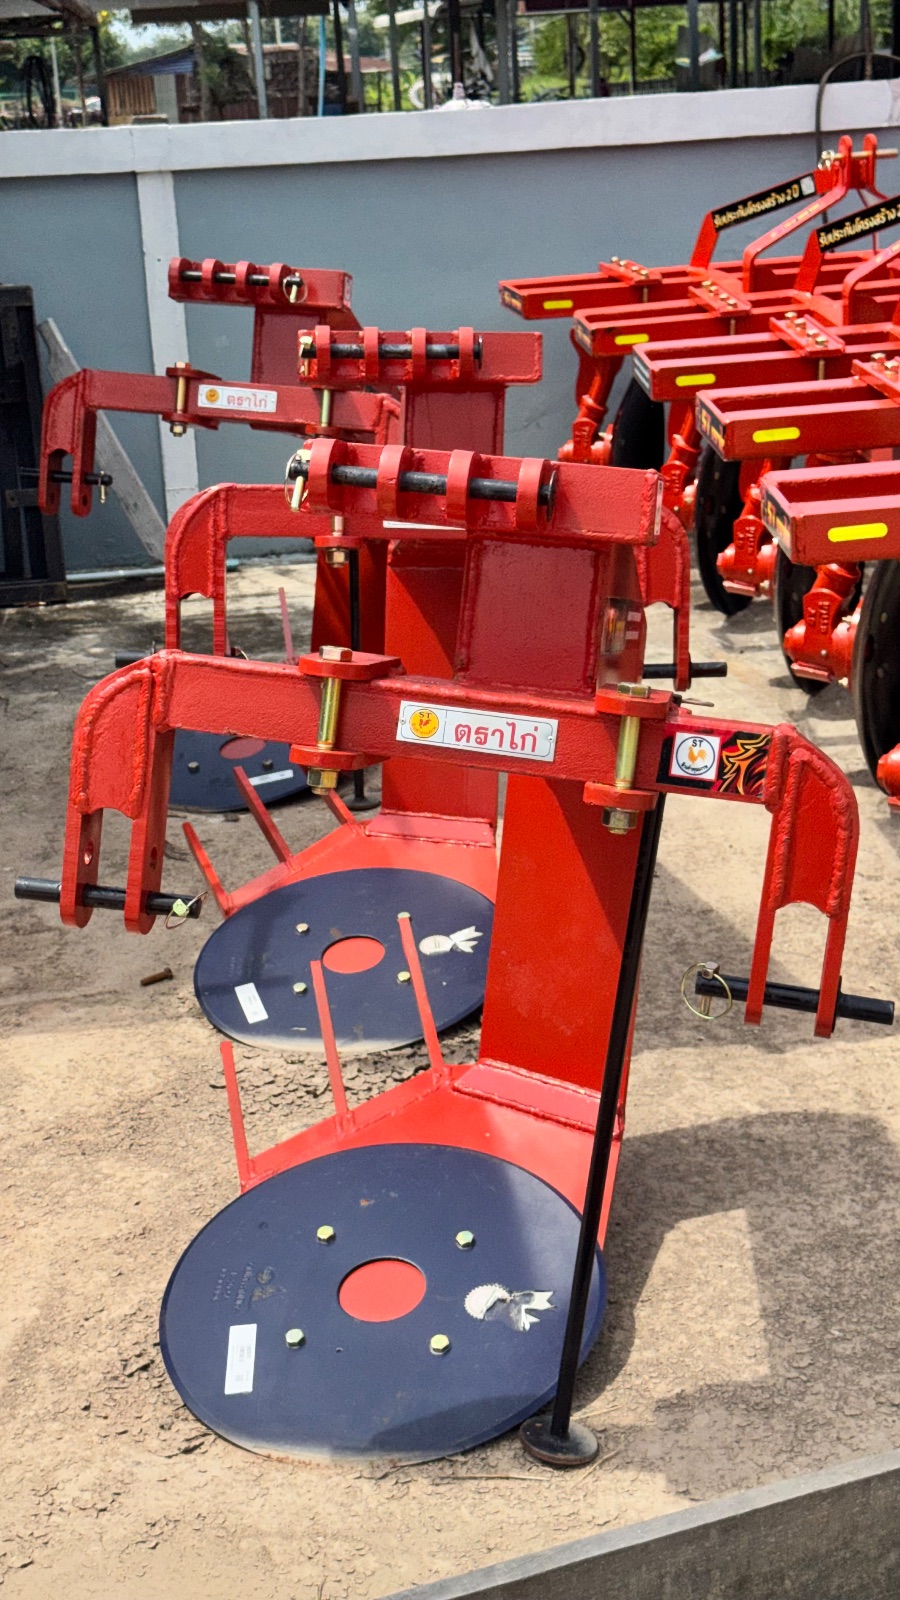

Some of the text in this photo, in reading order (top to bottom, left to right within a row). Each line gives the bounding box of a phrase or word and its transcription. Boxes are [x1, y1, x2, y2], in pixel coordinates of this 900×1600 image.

[226, 393, 269, 409] ตราไก่
[418, 711, 432, 719] ST
[454, 721, 539, 753] ตราไก่
[691, 738, 704, 748] ST
